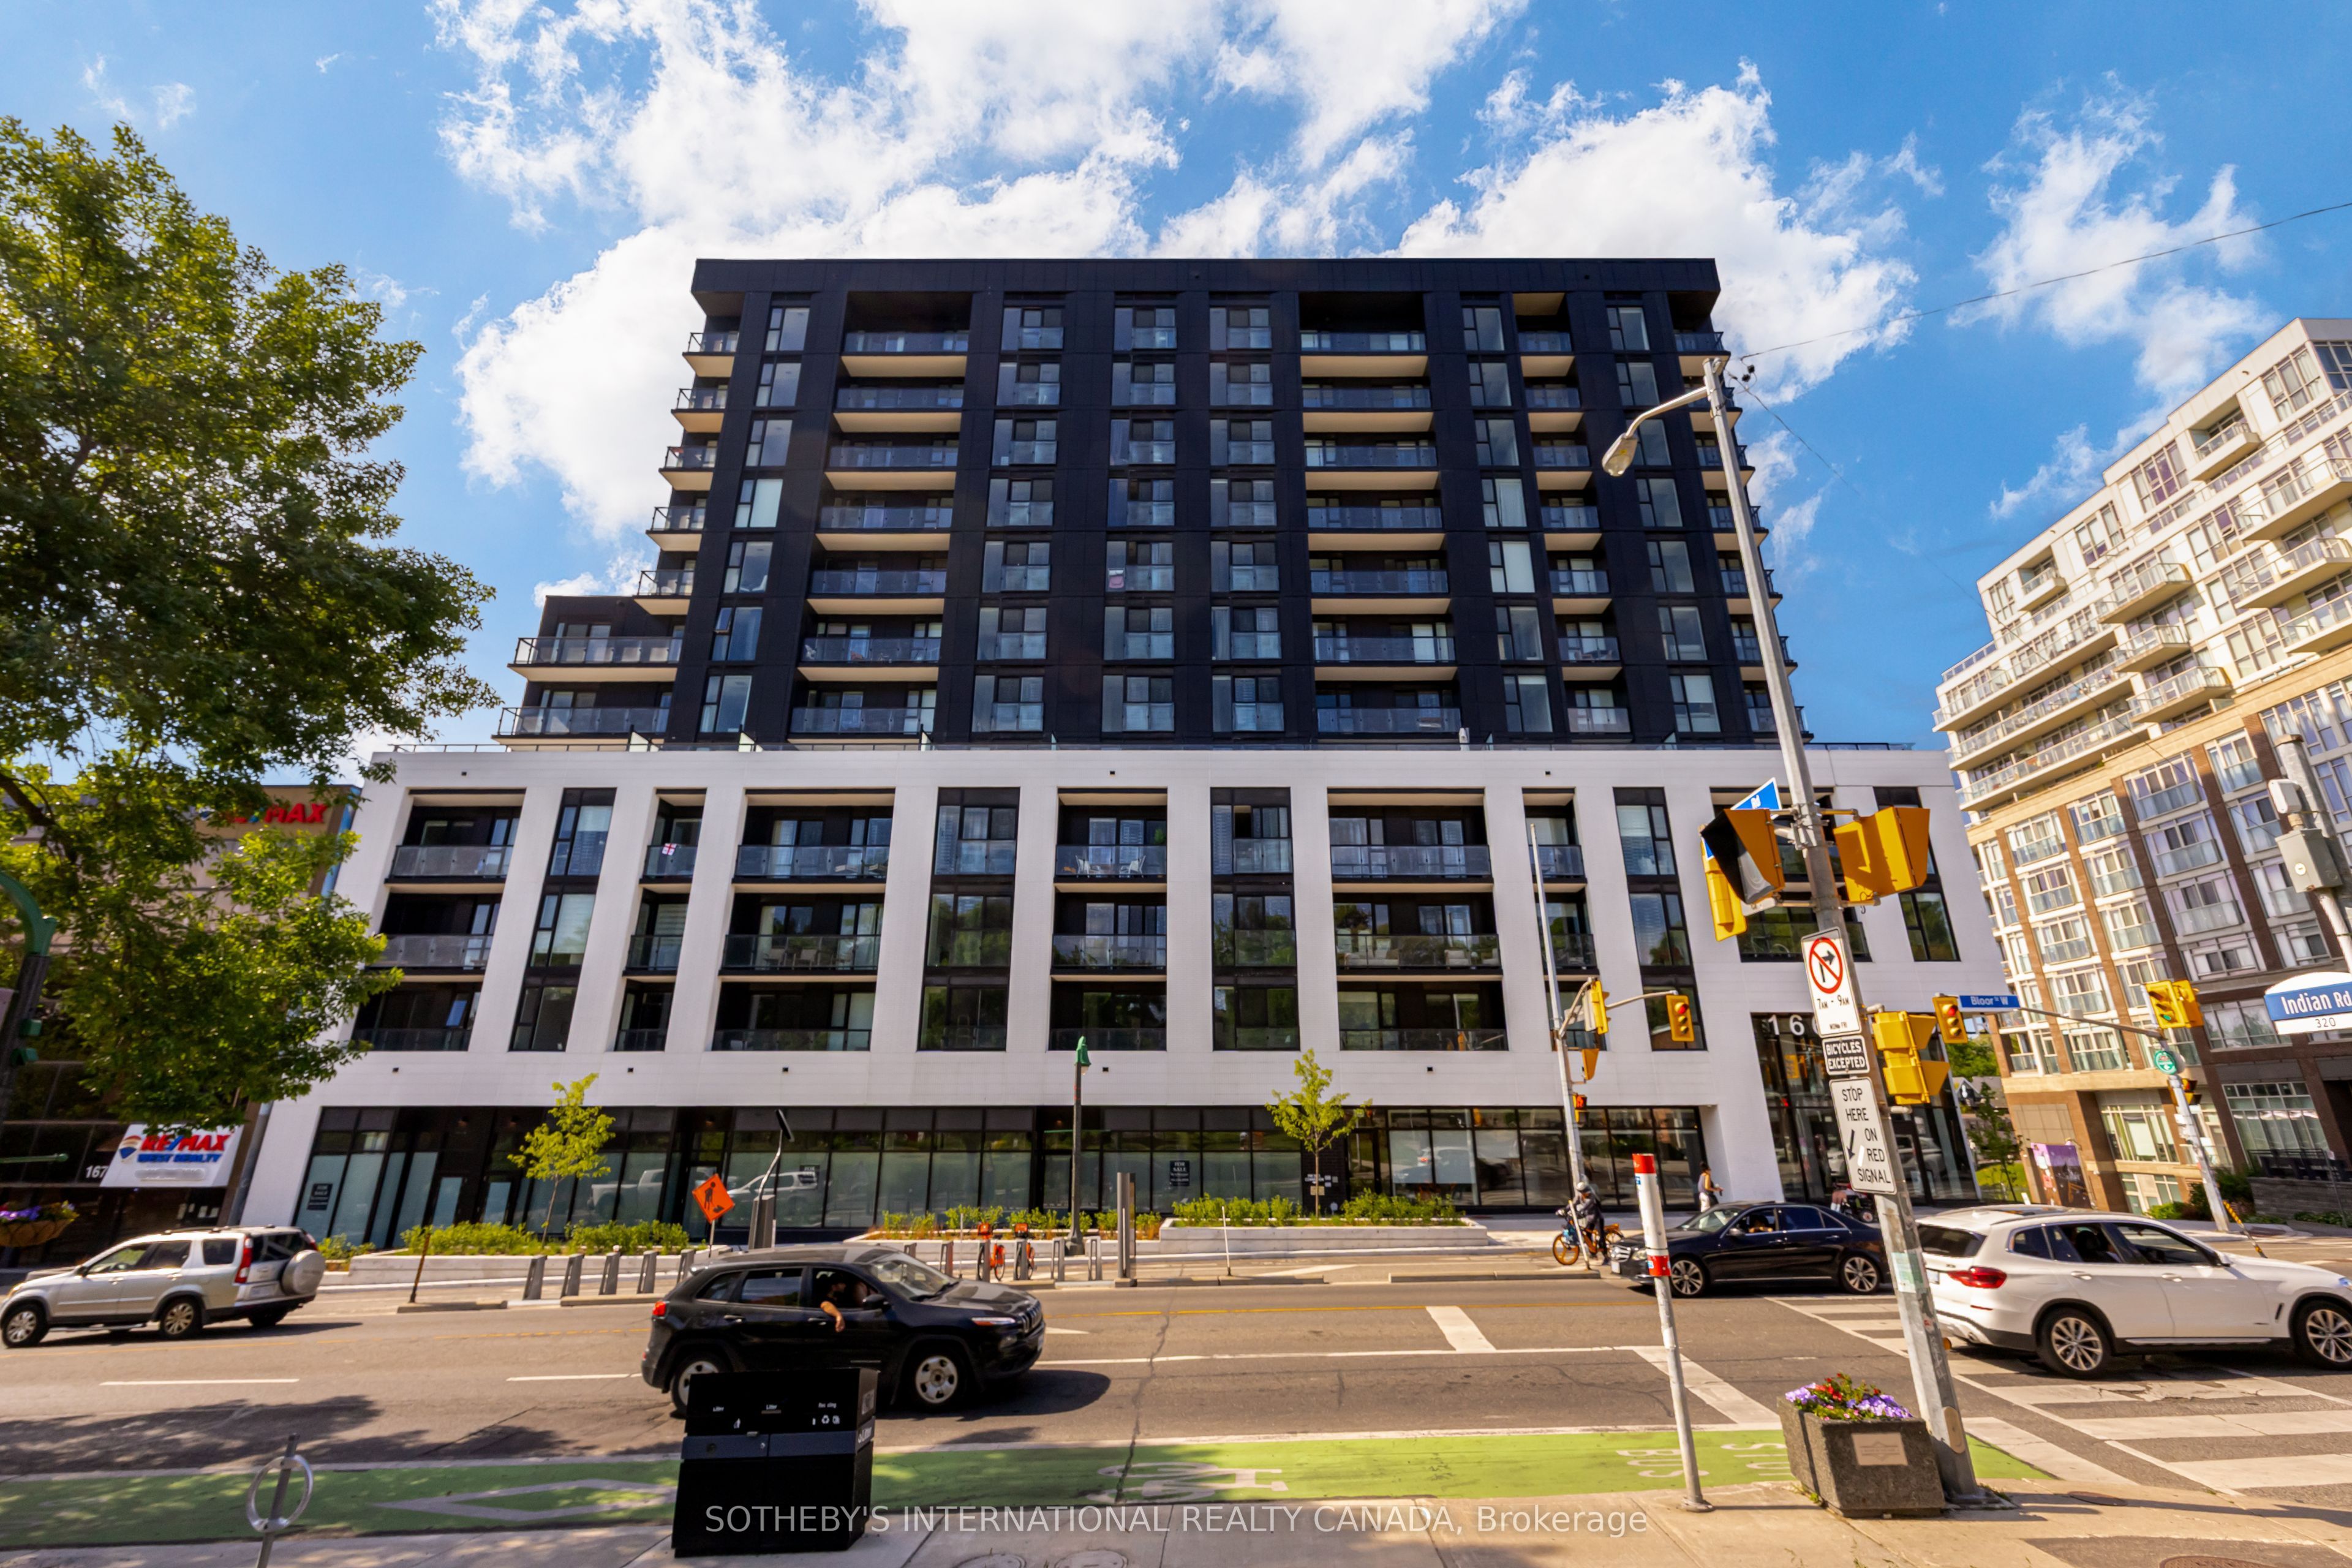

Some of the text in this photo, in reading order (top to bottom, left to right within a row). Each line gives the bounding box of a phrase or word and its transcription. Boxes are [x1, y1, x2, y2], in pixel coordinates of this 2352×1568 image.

[1817, 998, 1828, 1009] 7AM
[1838, 994, 1850, 1006] 9AM
[1970, 996, 1994, 1005] Bloor
[2000, 996, 2008, 1005] W
[2280, 990, 2352, 1015] Indian Rd
[2315, 1017, 2336, 1028] 320
[1825, 1041, 1862, 1055] BICYCLES
[1827, 1055, 1866, 1069] EXCEPTED
[1842, 1088, 1863, 1102] STOP
[1845, 1108, 1869, 1121] HERE
[1864, 1128, 1878, 1141] ON
[140, 1135, 230, 1152] RE/MAX
[1866, 1148, 1885, 1162] RED
[1857, 1168, 1891, 1183] SIGNAL
